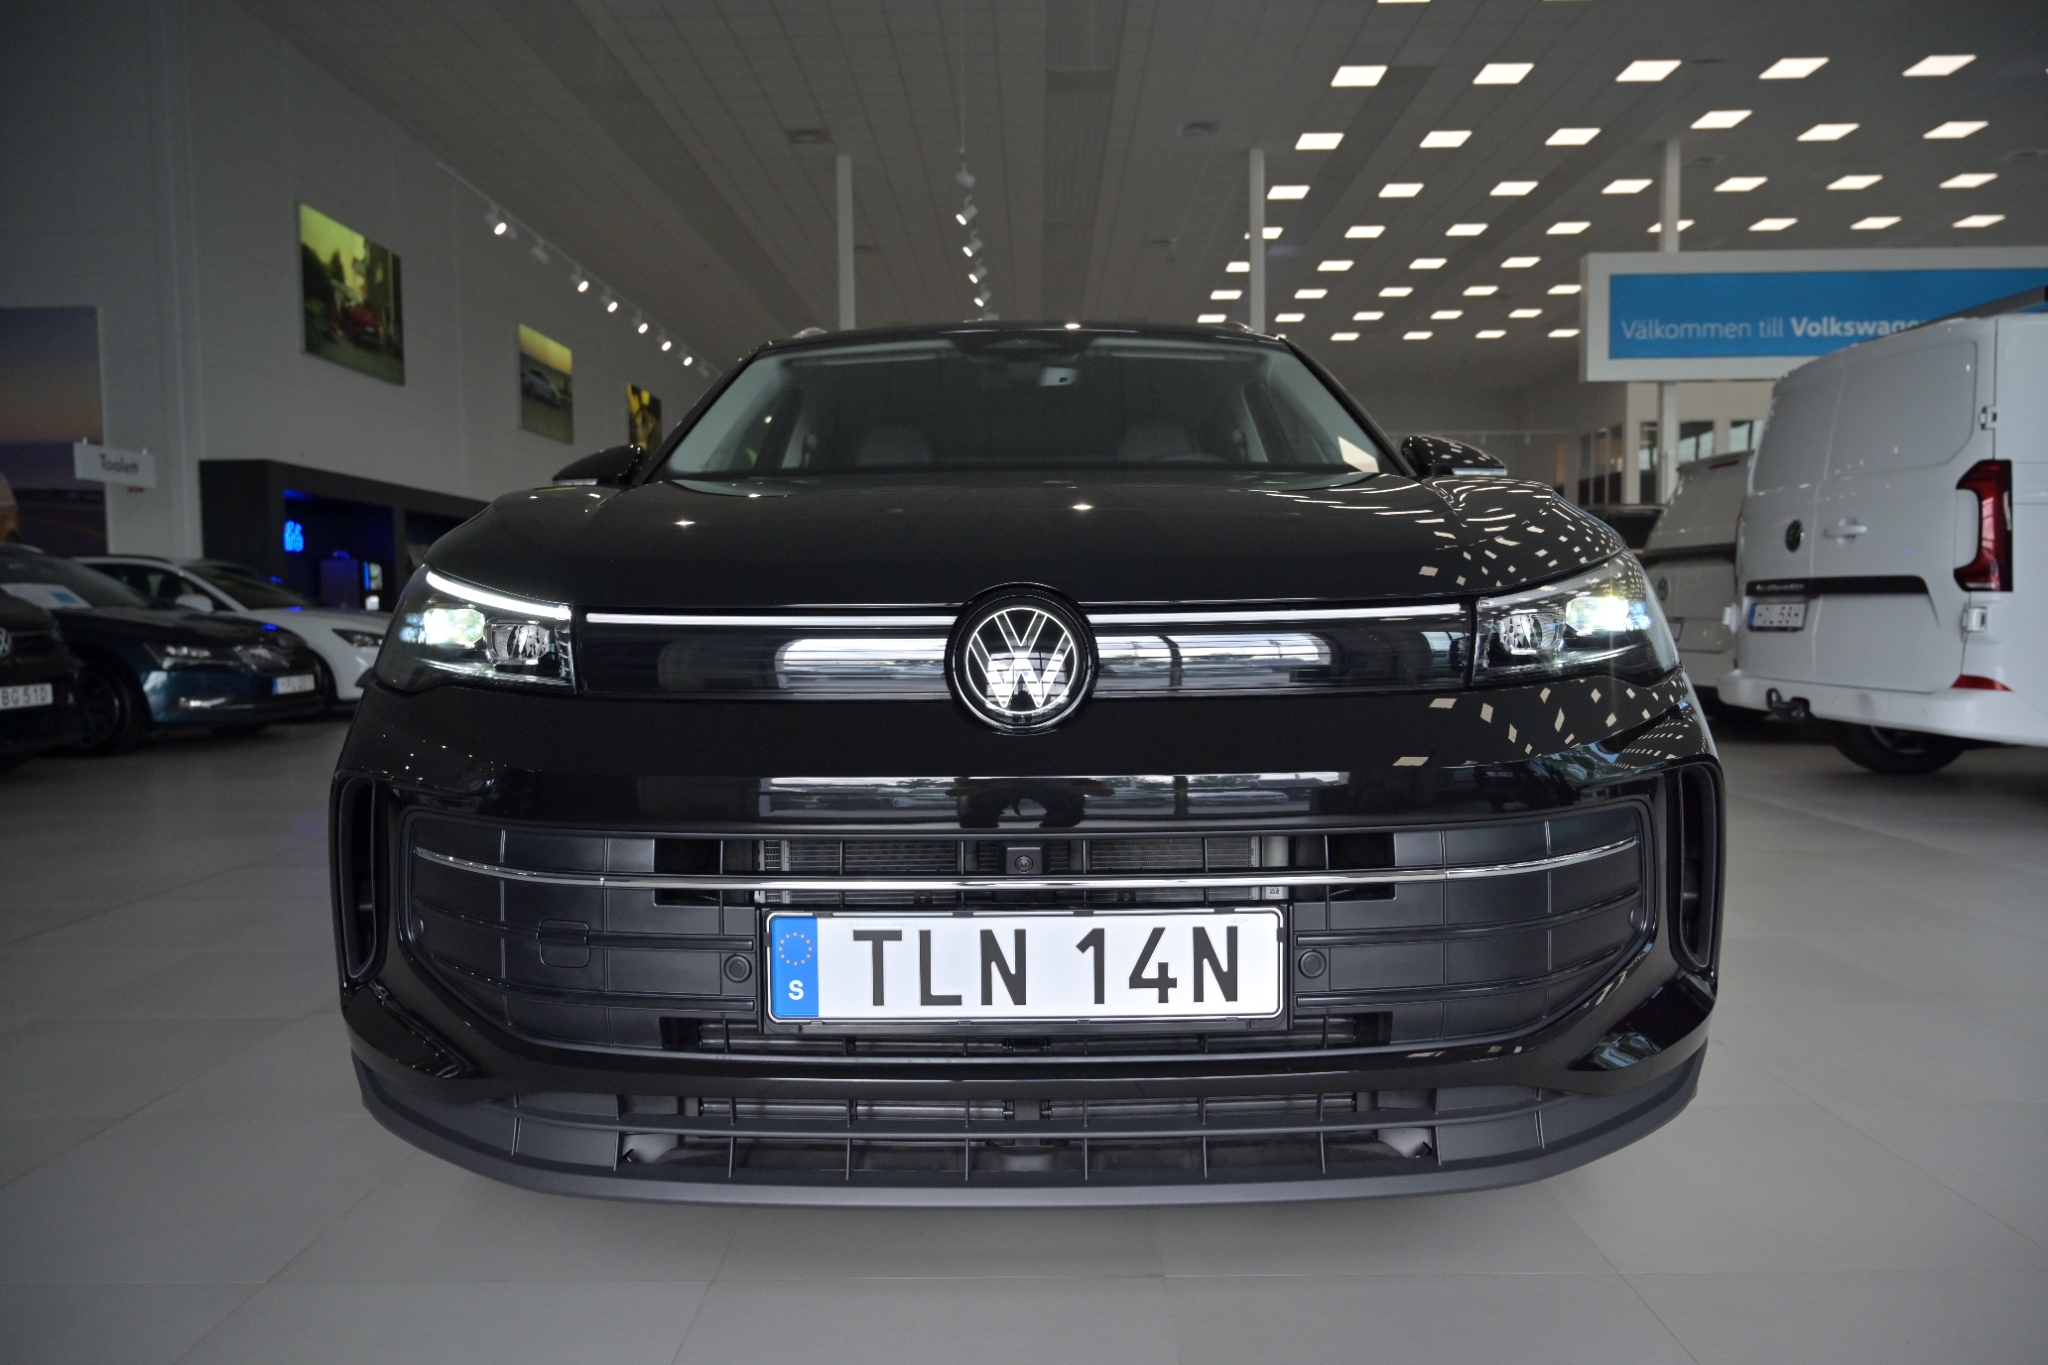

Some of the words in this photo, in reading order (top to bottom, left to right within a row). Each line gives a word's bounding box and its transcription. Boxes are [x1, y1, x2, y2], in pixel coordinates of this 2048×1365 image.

[1620, 318, 1752, 340] Välkommen
[1758, 317, 1784, 338] till
[852, 928, 1027, 1006] TLN
[1075, 925, 1239, 1004] 14N
[787, 979, 804, 1001] S
